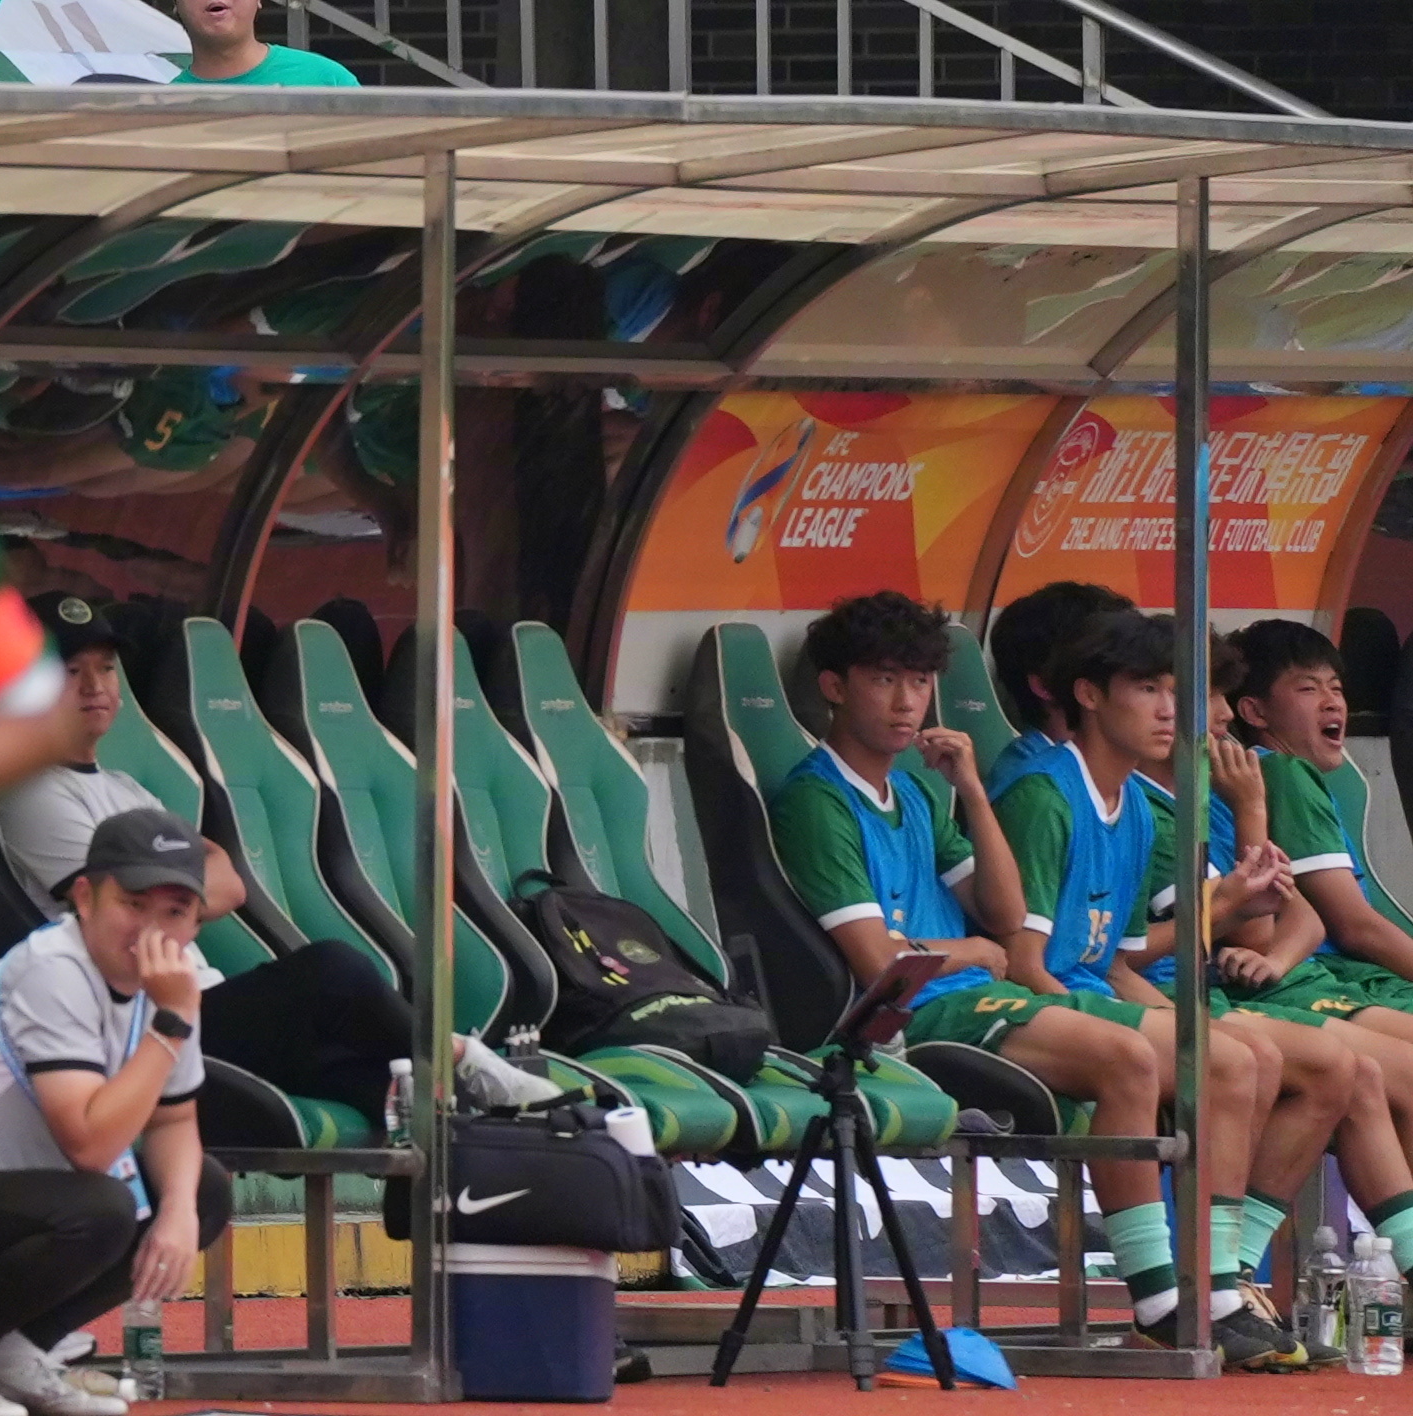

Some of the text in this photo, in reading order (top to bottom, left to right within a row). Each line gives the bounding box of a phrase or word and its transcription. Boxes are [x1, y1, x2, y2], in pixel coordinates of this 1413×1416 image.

[824, 432, 859, 456] AFC
[802, 462, 925, 501] CHAMPIONS
[1079, 431, 1370, 504] 浙江职足球俱乐部
[780, 508, 869, 547] LEAGUE
[1060, 518, 1128, 550] ZHEJIANG
[1222, 518, 1283, 551] FOOTBALL
[1286, 520, 1325, 553] CLUB
